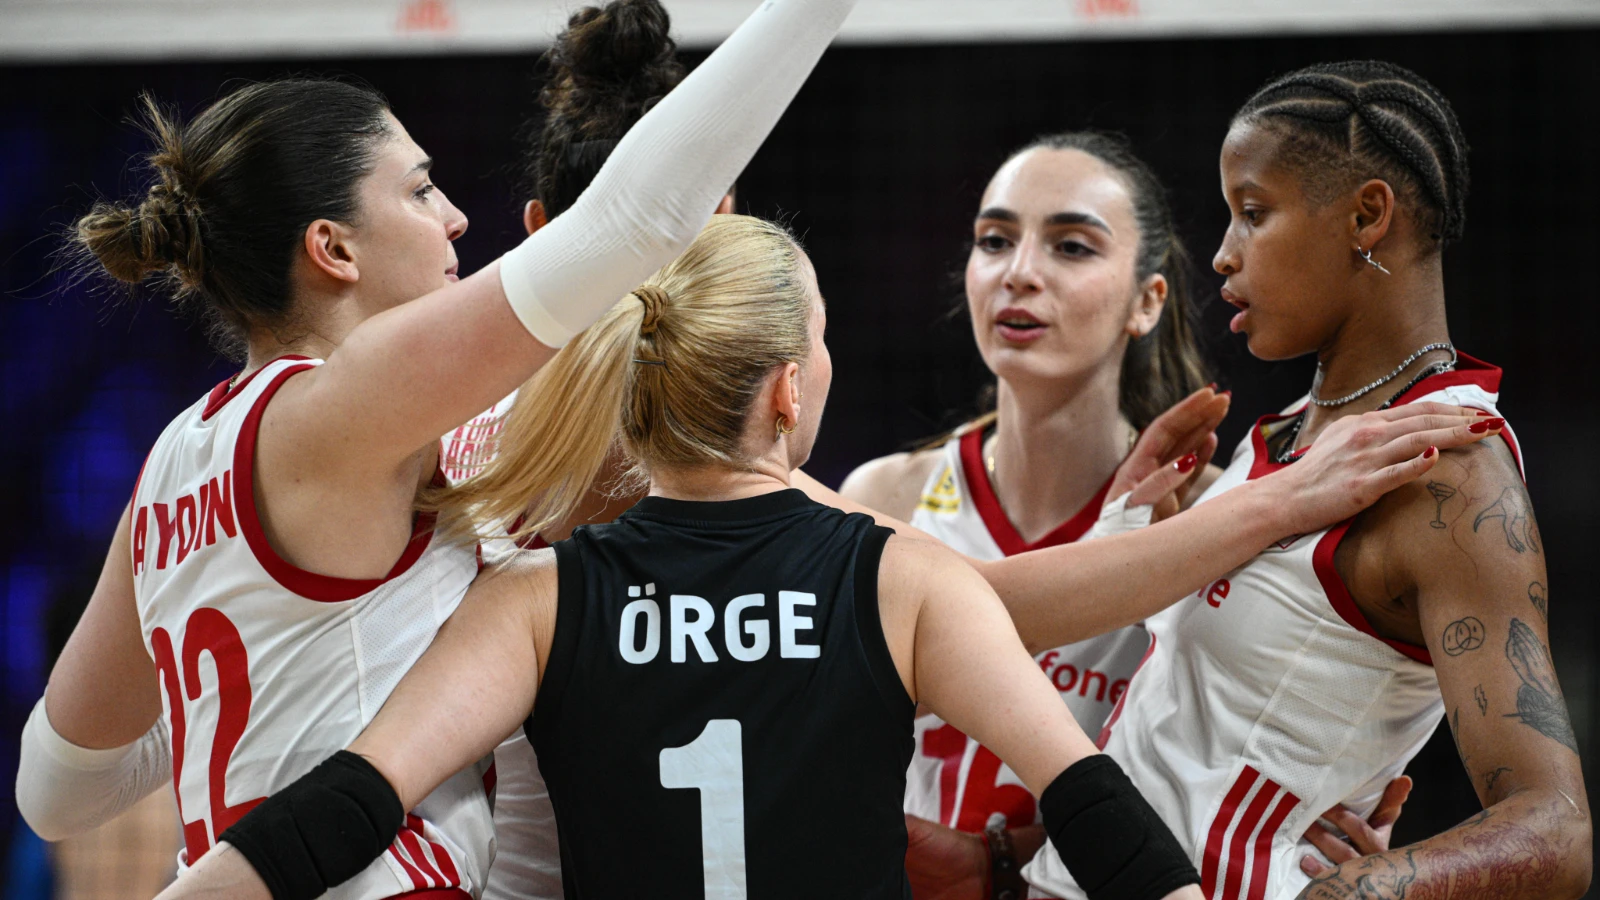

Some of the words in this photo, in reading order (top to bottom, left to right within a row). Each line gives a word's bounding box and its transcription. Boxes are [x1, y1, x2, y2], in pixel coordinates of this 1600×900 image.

[133, 469, 237, 576] AYDIN
[618, 582, 821, 665] ÖRGE
[658, 718, 748, 900] 1
[922, 723, 1036, 834] 16
